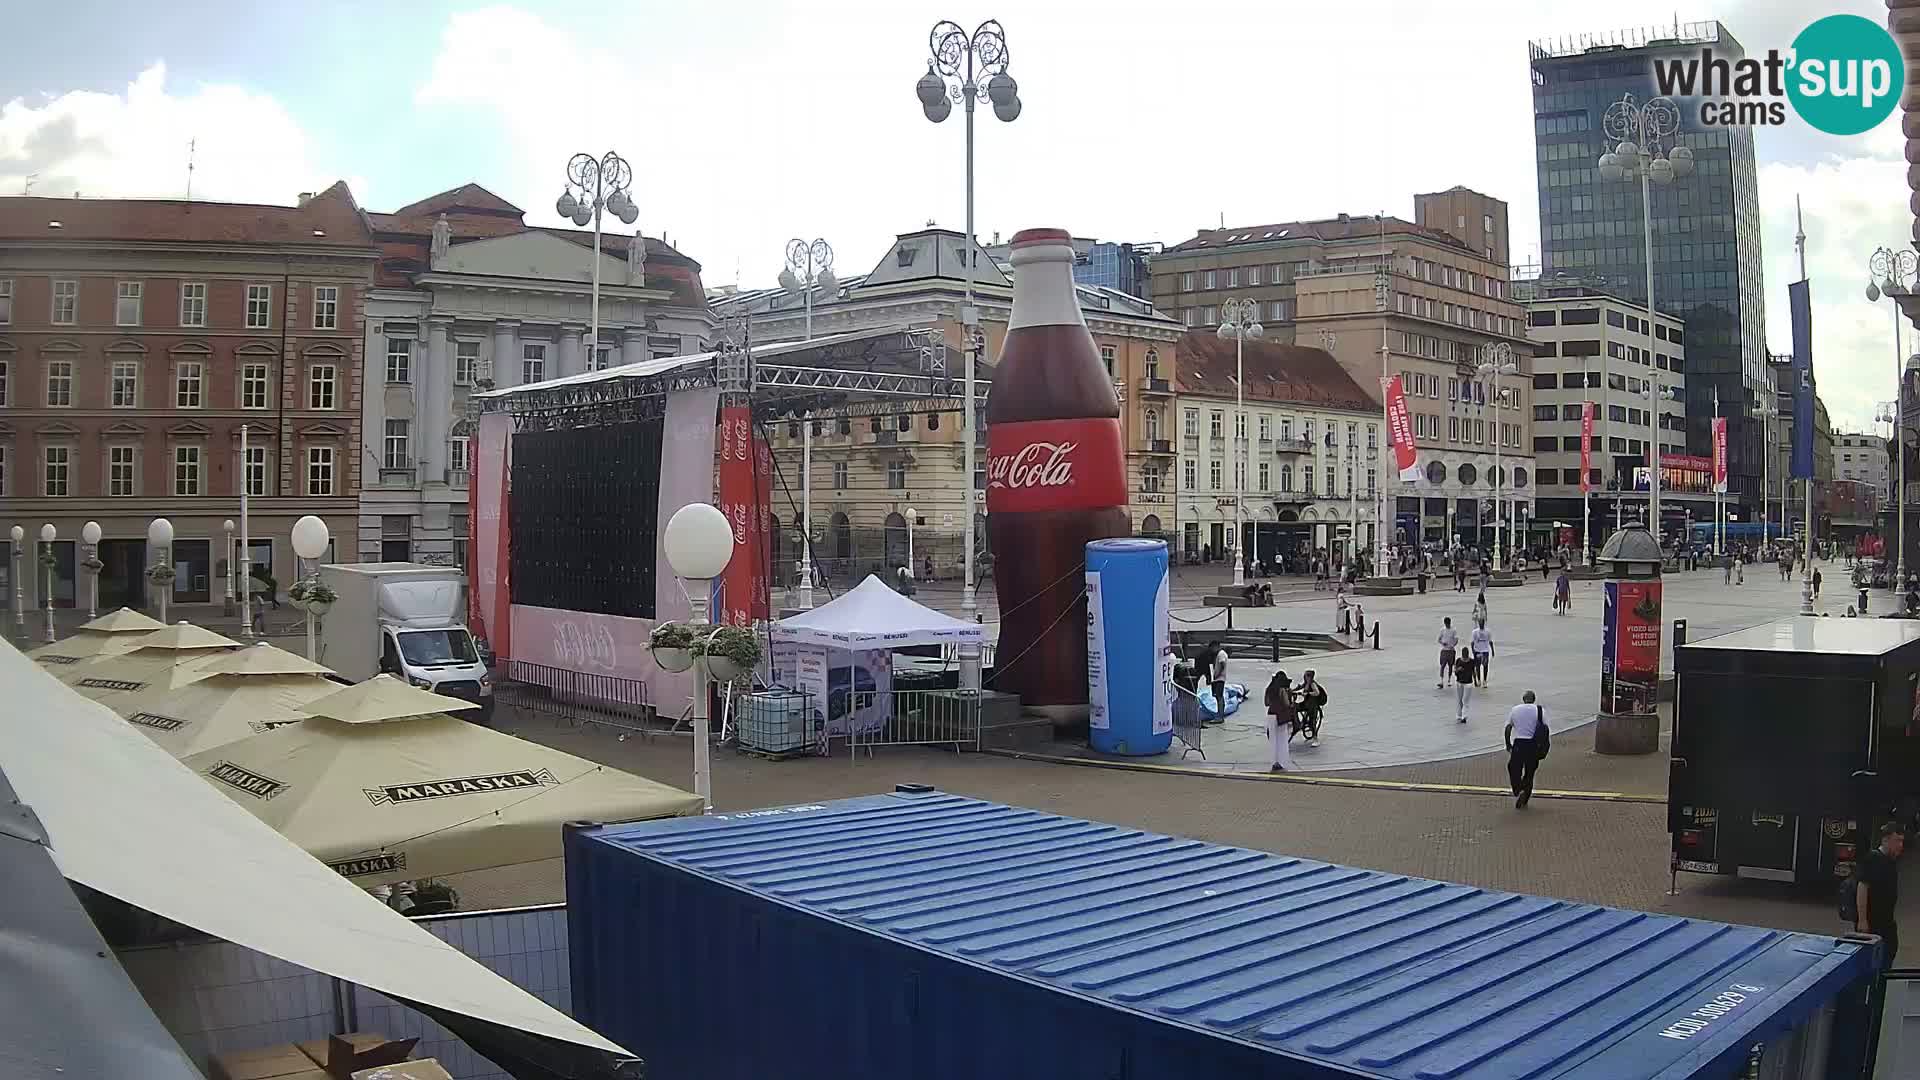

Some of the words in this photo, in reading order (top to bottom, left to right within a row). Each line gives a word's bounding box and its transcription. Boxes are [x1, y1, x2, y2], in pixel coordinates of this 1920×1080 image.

[214, 766, 274, 794] MARASKA
[396, 773, 533, 801] MARASKA
[338, 858, 391, 875] RASKA
